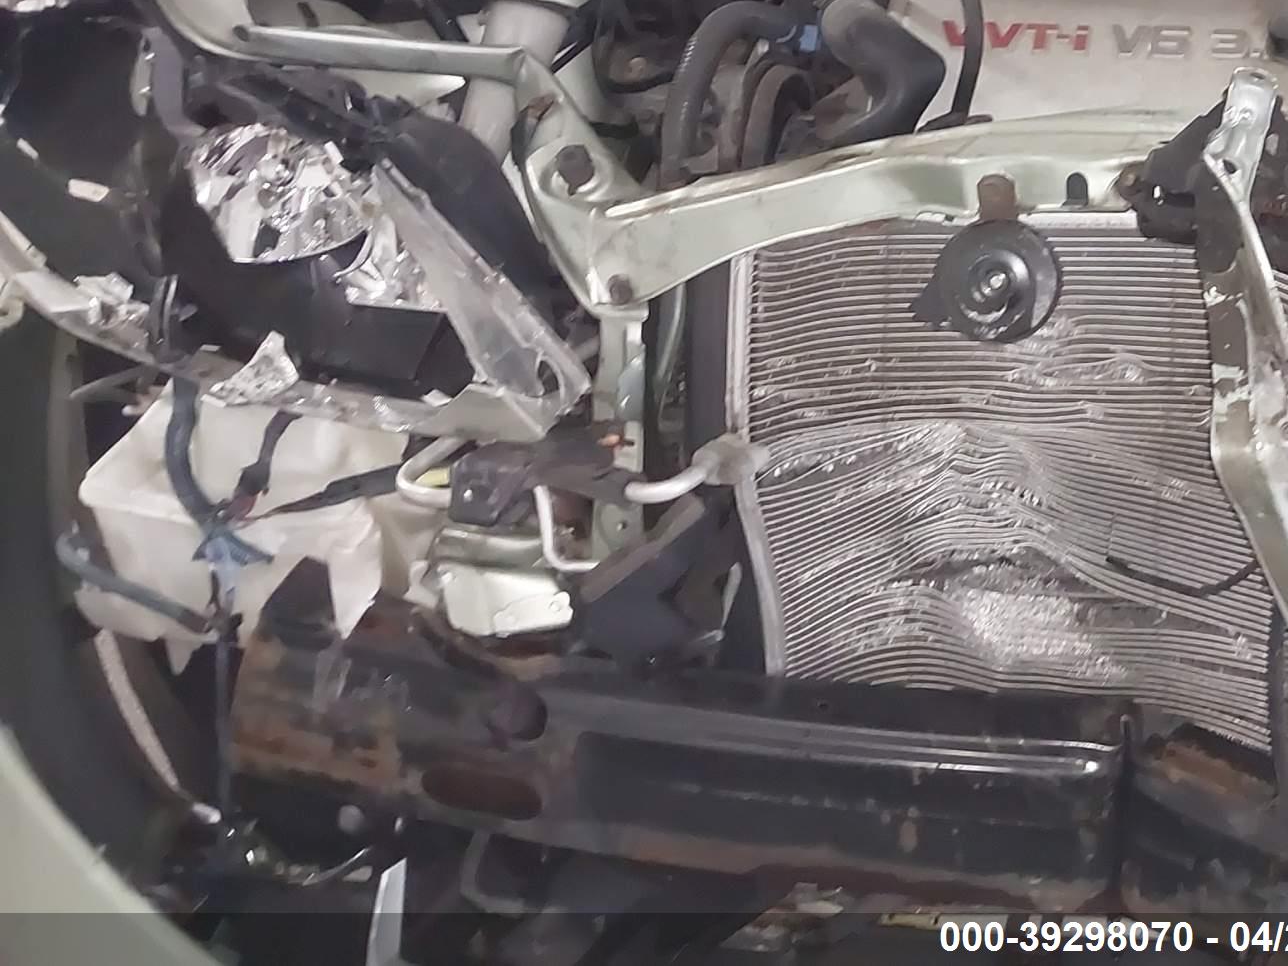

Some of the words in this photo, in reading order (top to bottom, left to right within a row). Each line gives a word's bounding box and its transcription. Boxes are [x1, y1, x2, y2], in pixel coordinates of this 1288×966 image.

[942, 20, 1090, 51] VVT-i
[1112, 23, 1193, 58] V6
[1210, 28, 1269, 58] 3.
